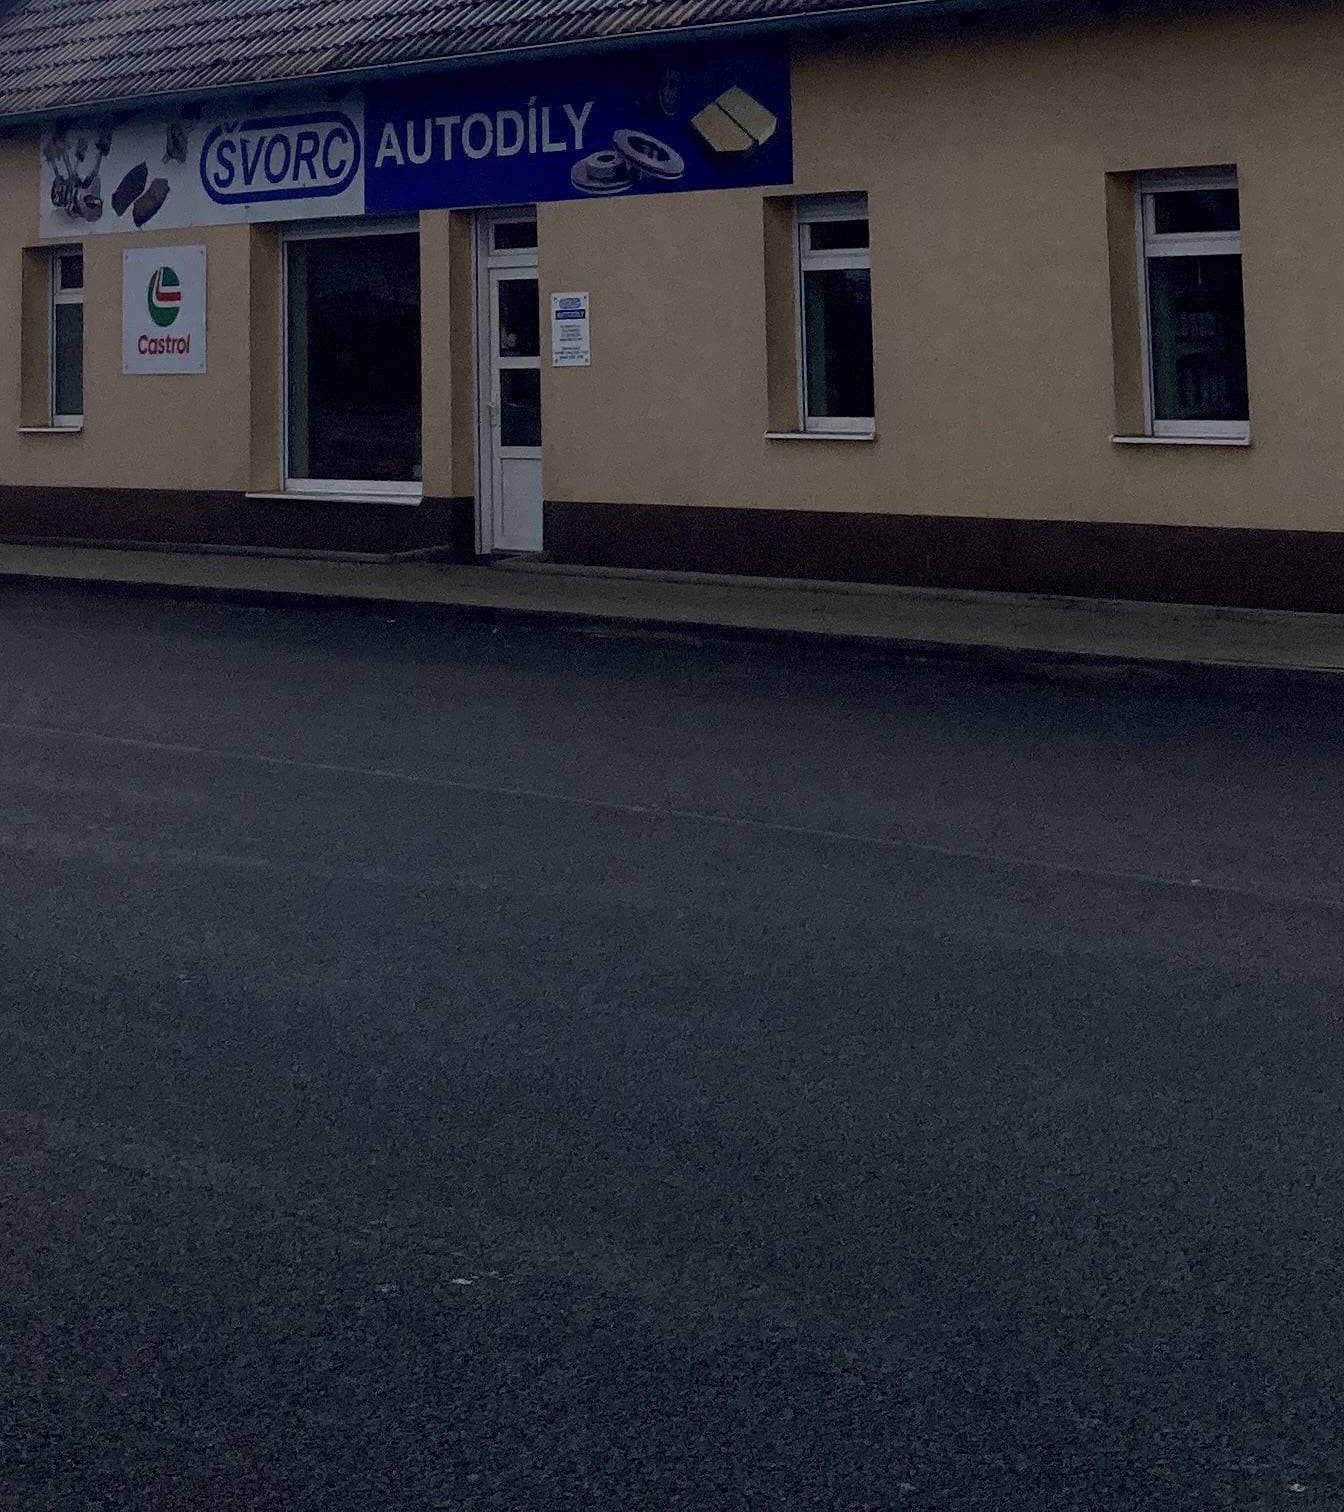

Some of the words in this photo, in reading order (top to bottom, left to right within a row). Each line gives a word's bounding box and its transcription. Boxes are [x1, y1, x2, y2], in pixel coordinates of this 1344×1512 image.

[213, 120, 351, 187] ŠVORC
[375, 96, 594, 167] AUTODÍLY
[138, 333, 190, 355] Castrol
